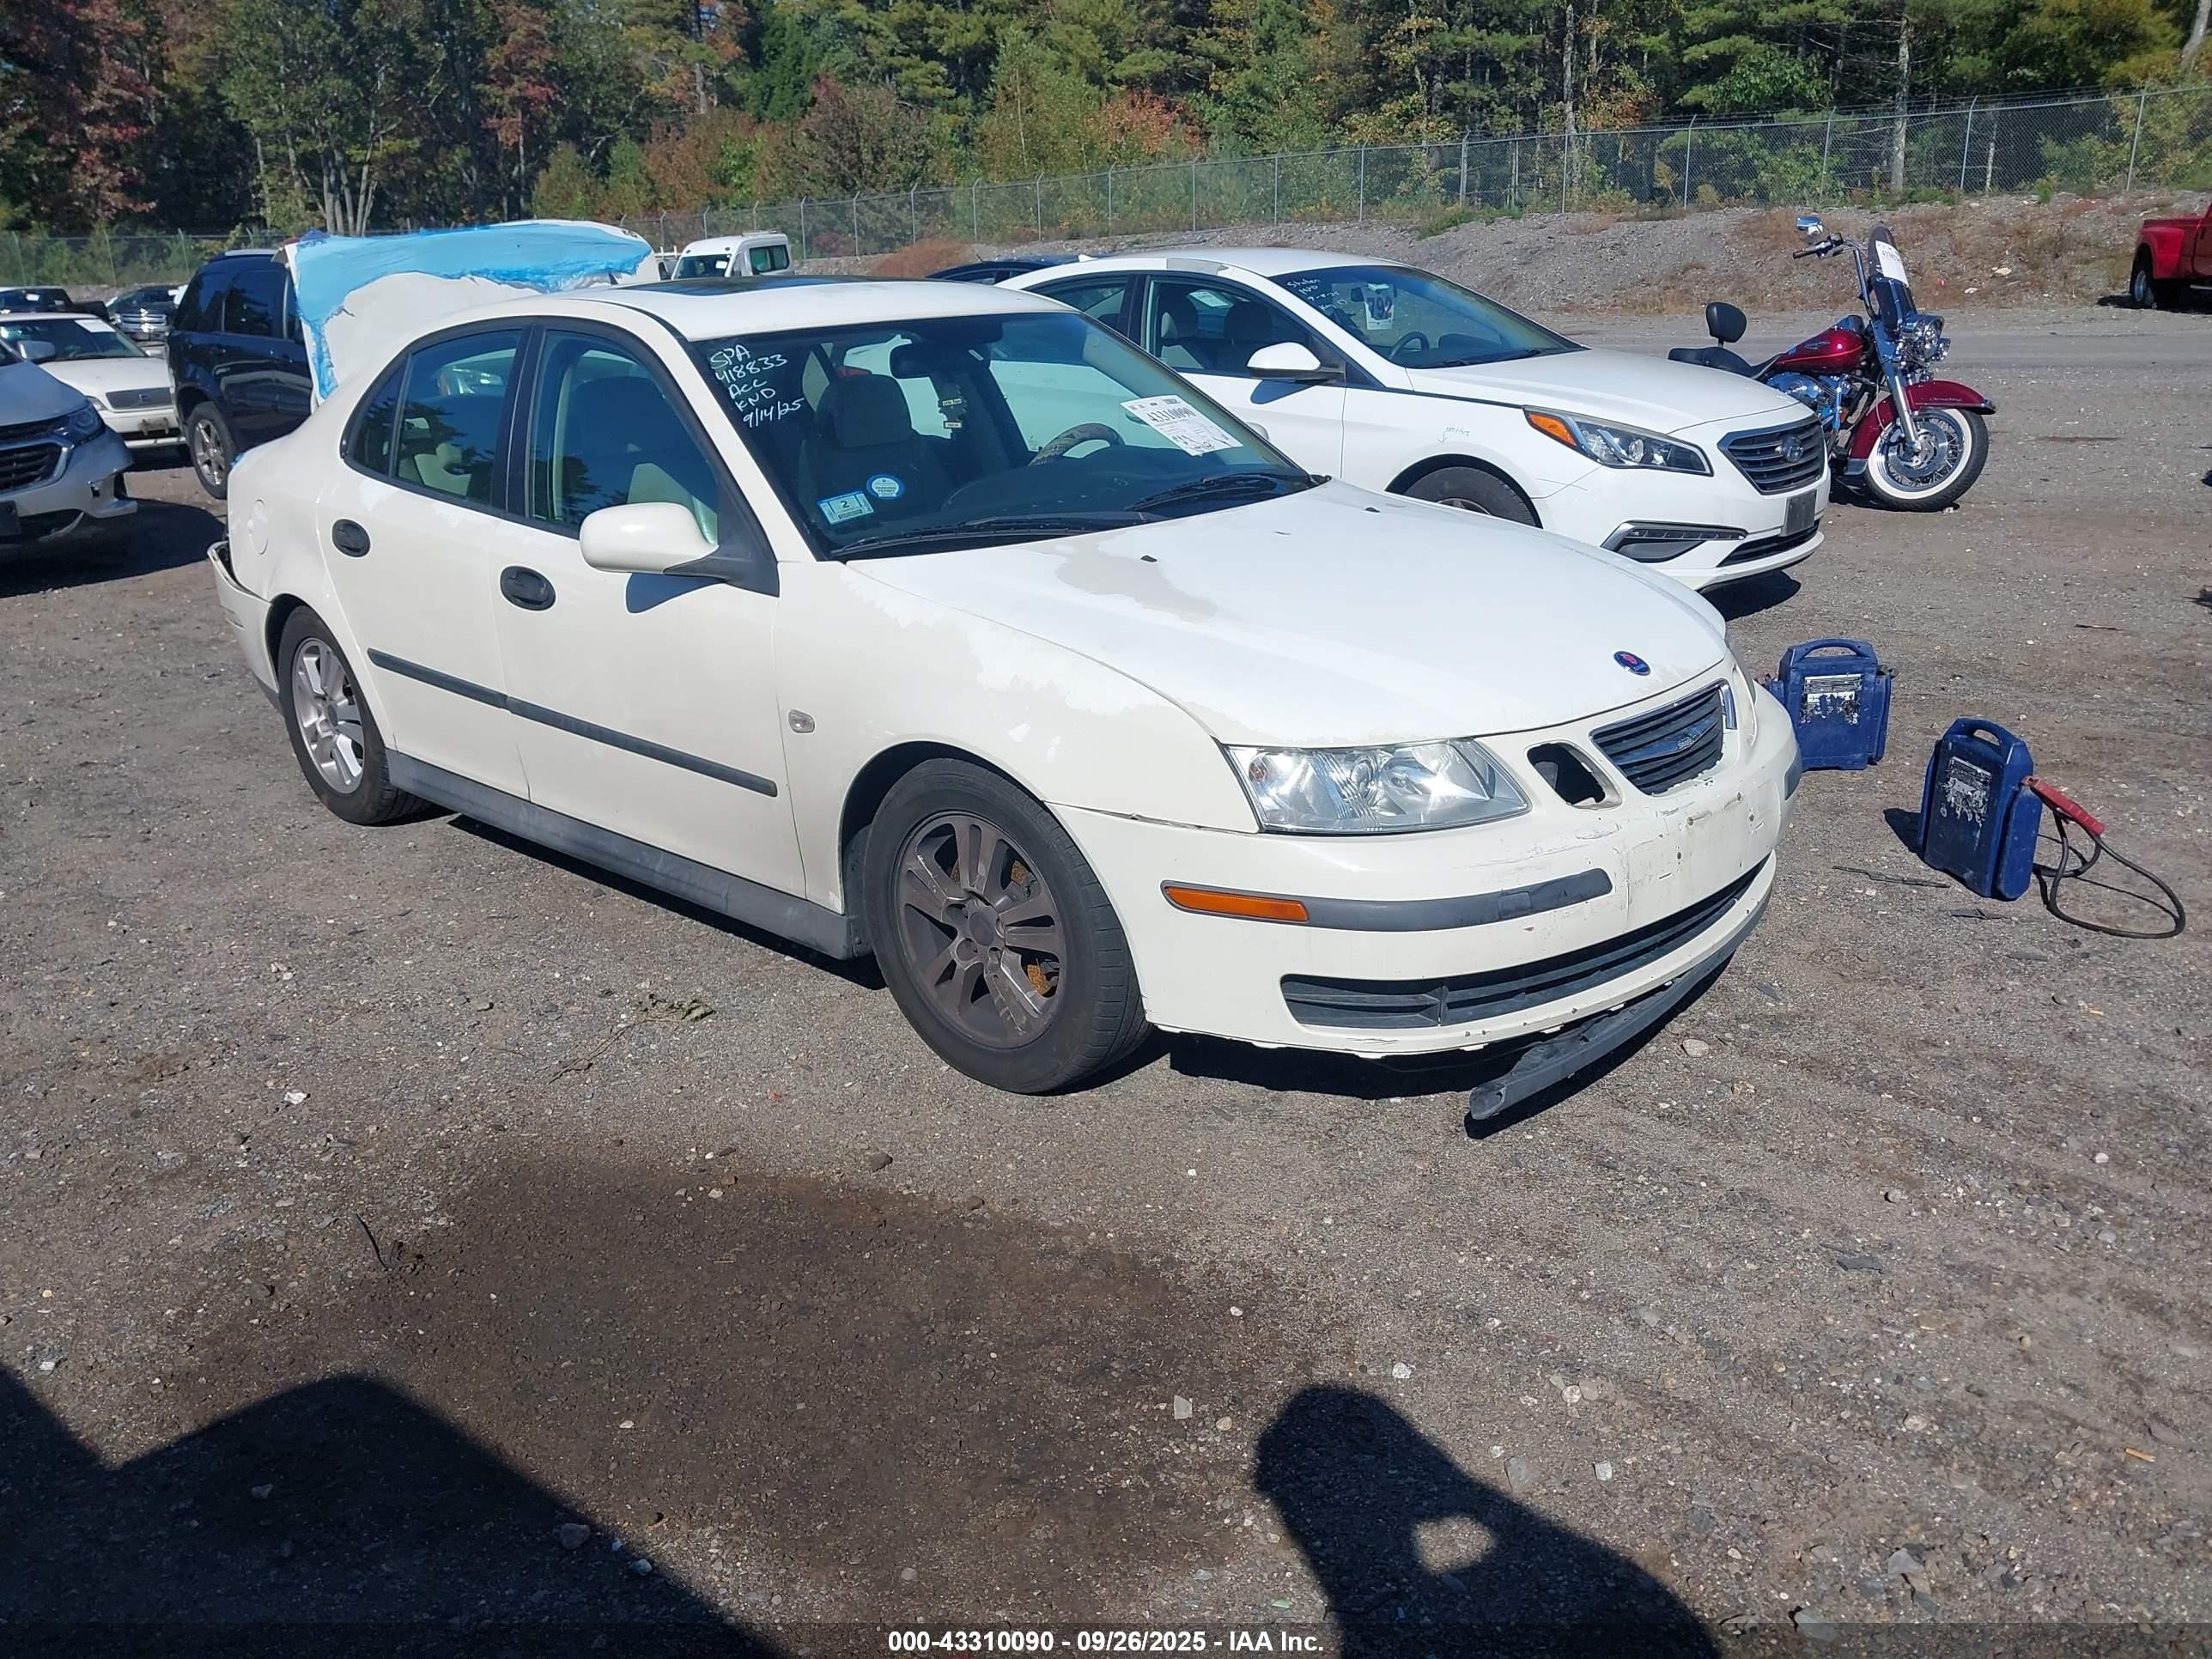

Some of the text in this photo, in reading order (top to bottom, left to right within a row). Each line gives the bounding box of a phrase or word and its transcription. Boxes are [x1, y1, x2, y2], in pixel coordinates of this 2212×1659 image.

[1366, 296, 1393, 320] 792
[709, 344, 751, 370] SPA
[714, 354, 788, 384] 418833
[743, 398, 805, 428] 9/14/25
[1146, 406, 1196, 423] 43310090
